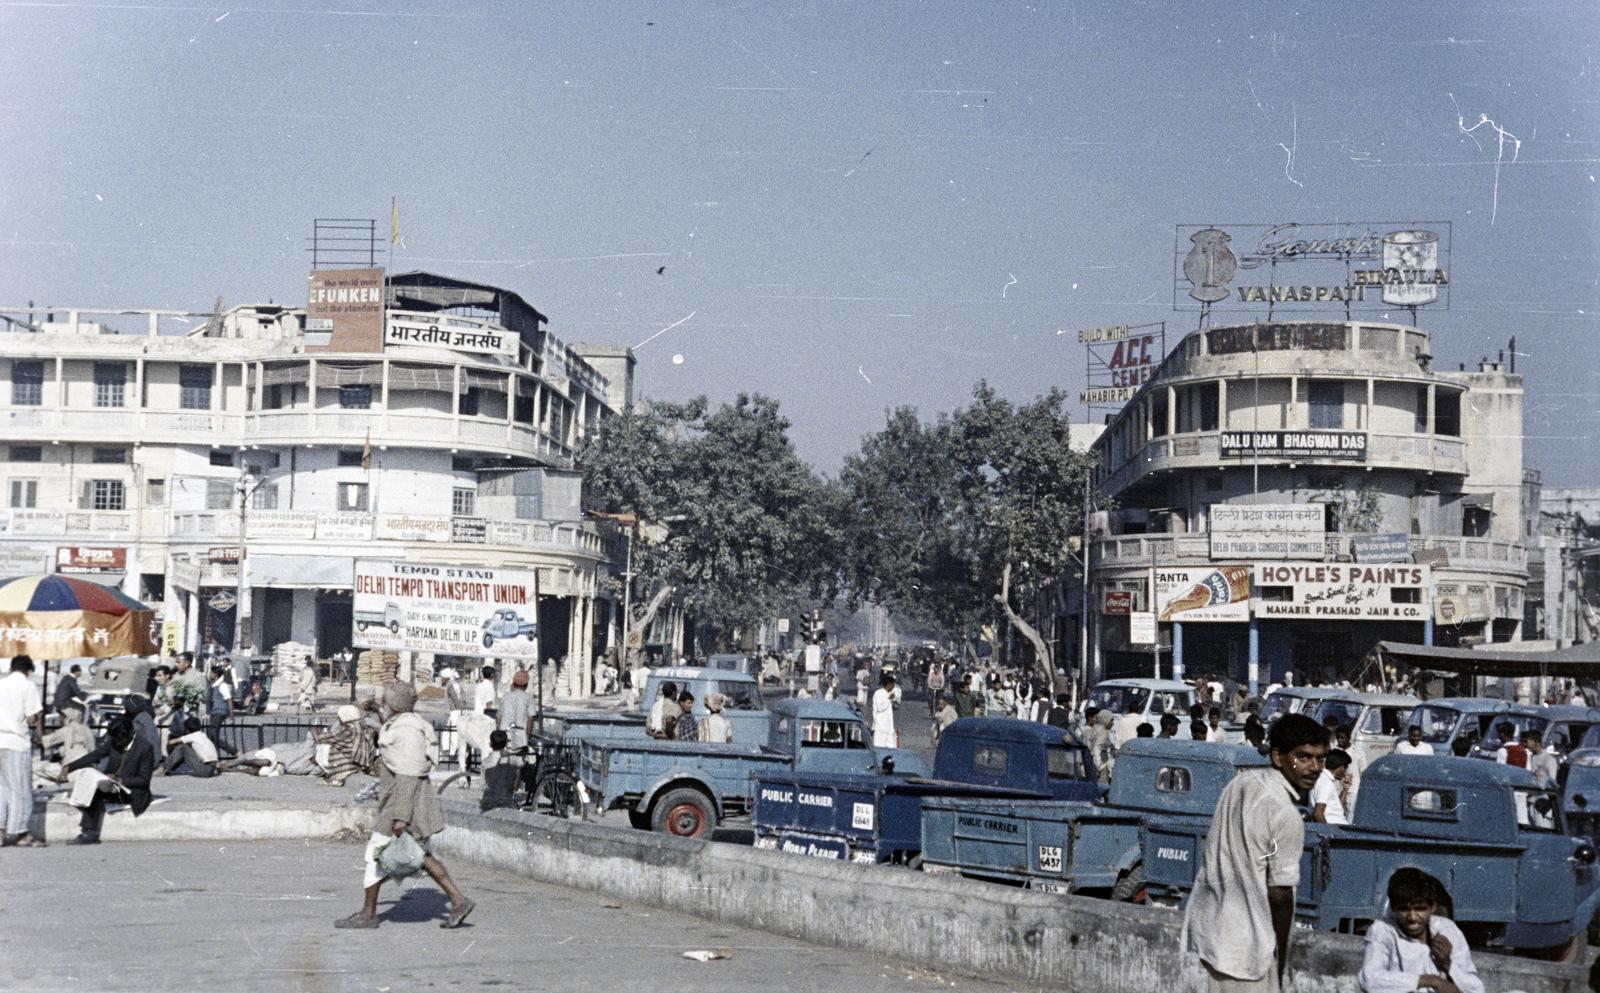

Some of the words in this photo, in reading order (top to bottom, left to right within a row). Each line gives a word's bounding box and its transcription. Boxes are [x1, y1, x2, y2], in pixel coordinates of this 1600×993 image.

[324, 279, 337, 287] the
[1354, 268, 1448, 285] BINAULA
[1238, 285, 1364, 302] VANASPATI
[344, 305, 379, 313] standard
[391, 325, 452, 345] भारतीय
[453, 331, 502, 349] जनसंघ
[1078, 329, 1102, 343] BUILD
[1106, 325, 1128, 340] WITH
[1109, 335, 1152, 369] ACC
[1080, 389, 1115, 404] MAHABIR
[1222, 433, 1250, 448] DALU
[1253, 433, 1277, 448] RAM
[1284, 433, 1339, 448] BHAGWAN
[1341, 435, 1365, 449] DAS
[1214, 508, 1239, 520] दिल्ली
[1242, 508, 1262, 521] प्रदेश
[1295, 507, 1321, 520] कमेटी
[1213, 542, 1229, 552] DELHI
[1231, 542, 1256, 552] PRADESH
[1258, 542, 1288, 552] CONGRESS
[1290, 542, 1322, 552] COMMITTEE
[393, 565, 439, 576] TEMPO
[446, 569, 493, 579] STAND
[1263, 566, 1341, 583] HOYLE'S
[1349, 567, 1422, 584] PAINTS
[356, 575, 385, 595] DELHI
[388, 576, 423, 598] TEMPO
[425, 579, 490, 602] TRANSPORT
[493, 583, 526, 605] UNION
[407, 611, 420, 620] DAY
[427, 613, 446, 623] NIGHT
[450, 615, 480, 626] SERVICE
[1266, 606, 1310, 614] MAHABIR
[1316, 606, 1361, 615] PRASHAD
[1367, 607, 1389, 615] JAIN
[1393, 608, 1400, 616] &
[1403, 608, 1420, 616] CO.
[406, 626, 437, 639] HARYANA
[440, 628, 460, 641] DELHI
[405, 640, 424, 648] ALSO
[425, 641, 447, 650] LOCAL
[451, 644, 480, 653] SERVICE
[761, 789, 793, 803] PUBLIC
[798, 793, 833, 807] CARRIER
[958, 815, 982, 827] PUBLIC
[984, 820, 1018, 834] CARRIER
[782, 839, 807, 855] HORN
[808, 843, 839, 860] PLEASE
[1041, 847, 1058, 856] DLG
[1157, 847, 1189, 862] PUBLIC
[1040, 857, 1060, 868] 6437
